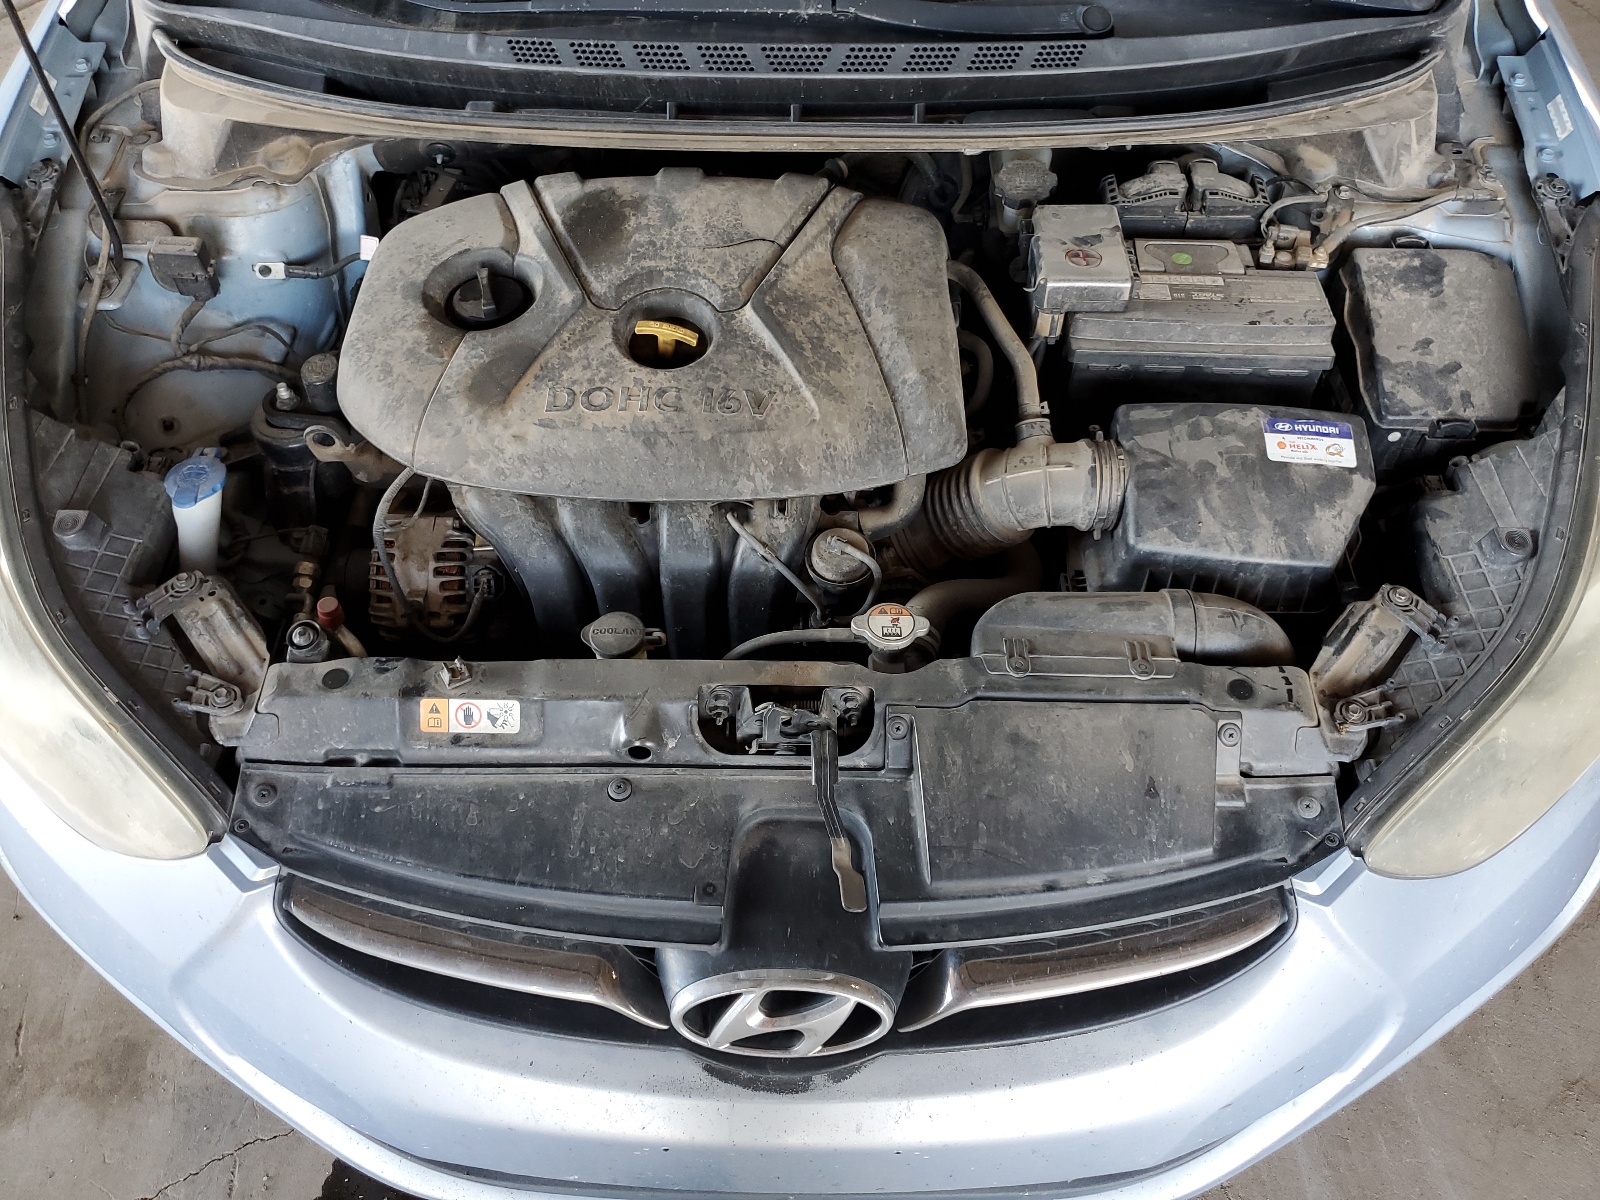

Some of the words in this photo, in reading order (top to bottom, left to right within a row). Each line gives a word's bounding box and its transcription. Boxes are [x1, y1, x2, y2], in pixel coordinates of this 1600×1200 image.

[545, 387, 682, 412] DOHC
[702, 387, 777, 417] 16V
[1295, 424, 1340, 435] HYUNDAI
[1289, 442, 1318, 450] HELIX
